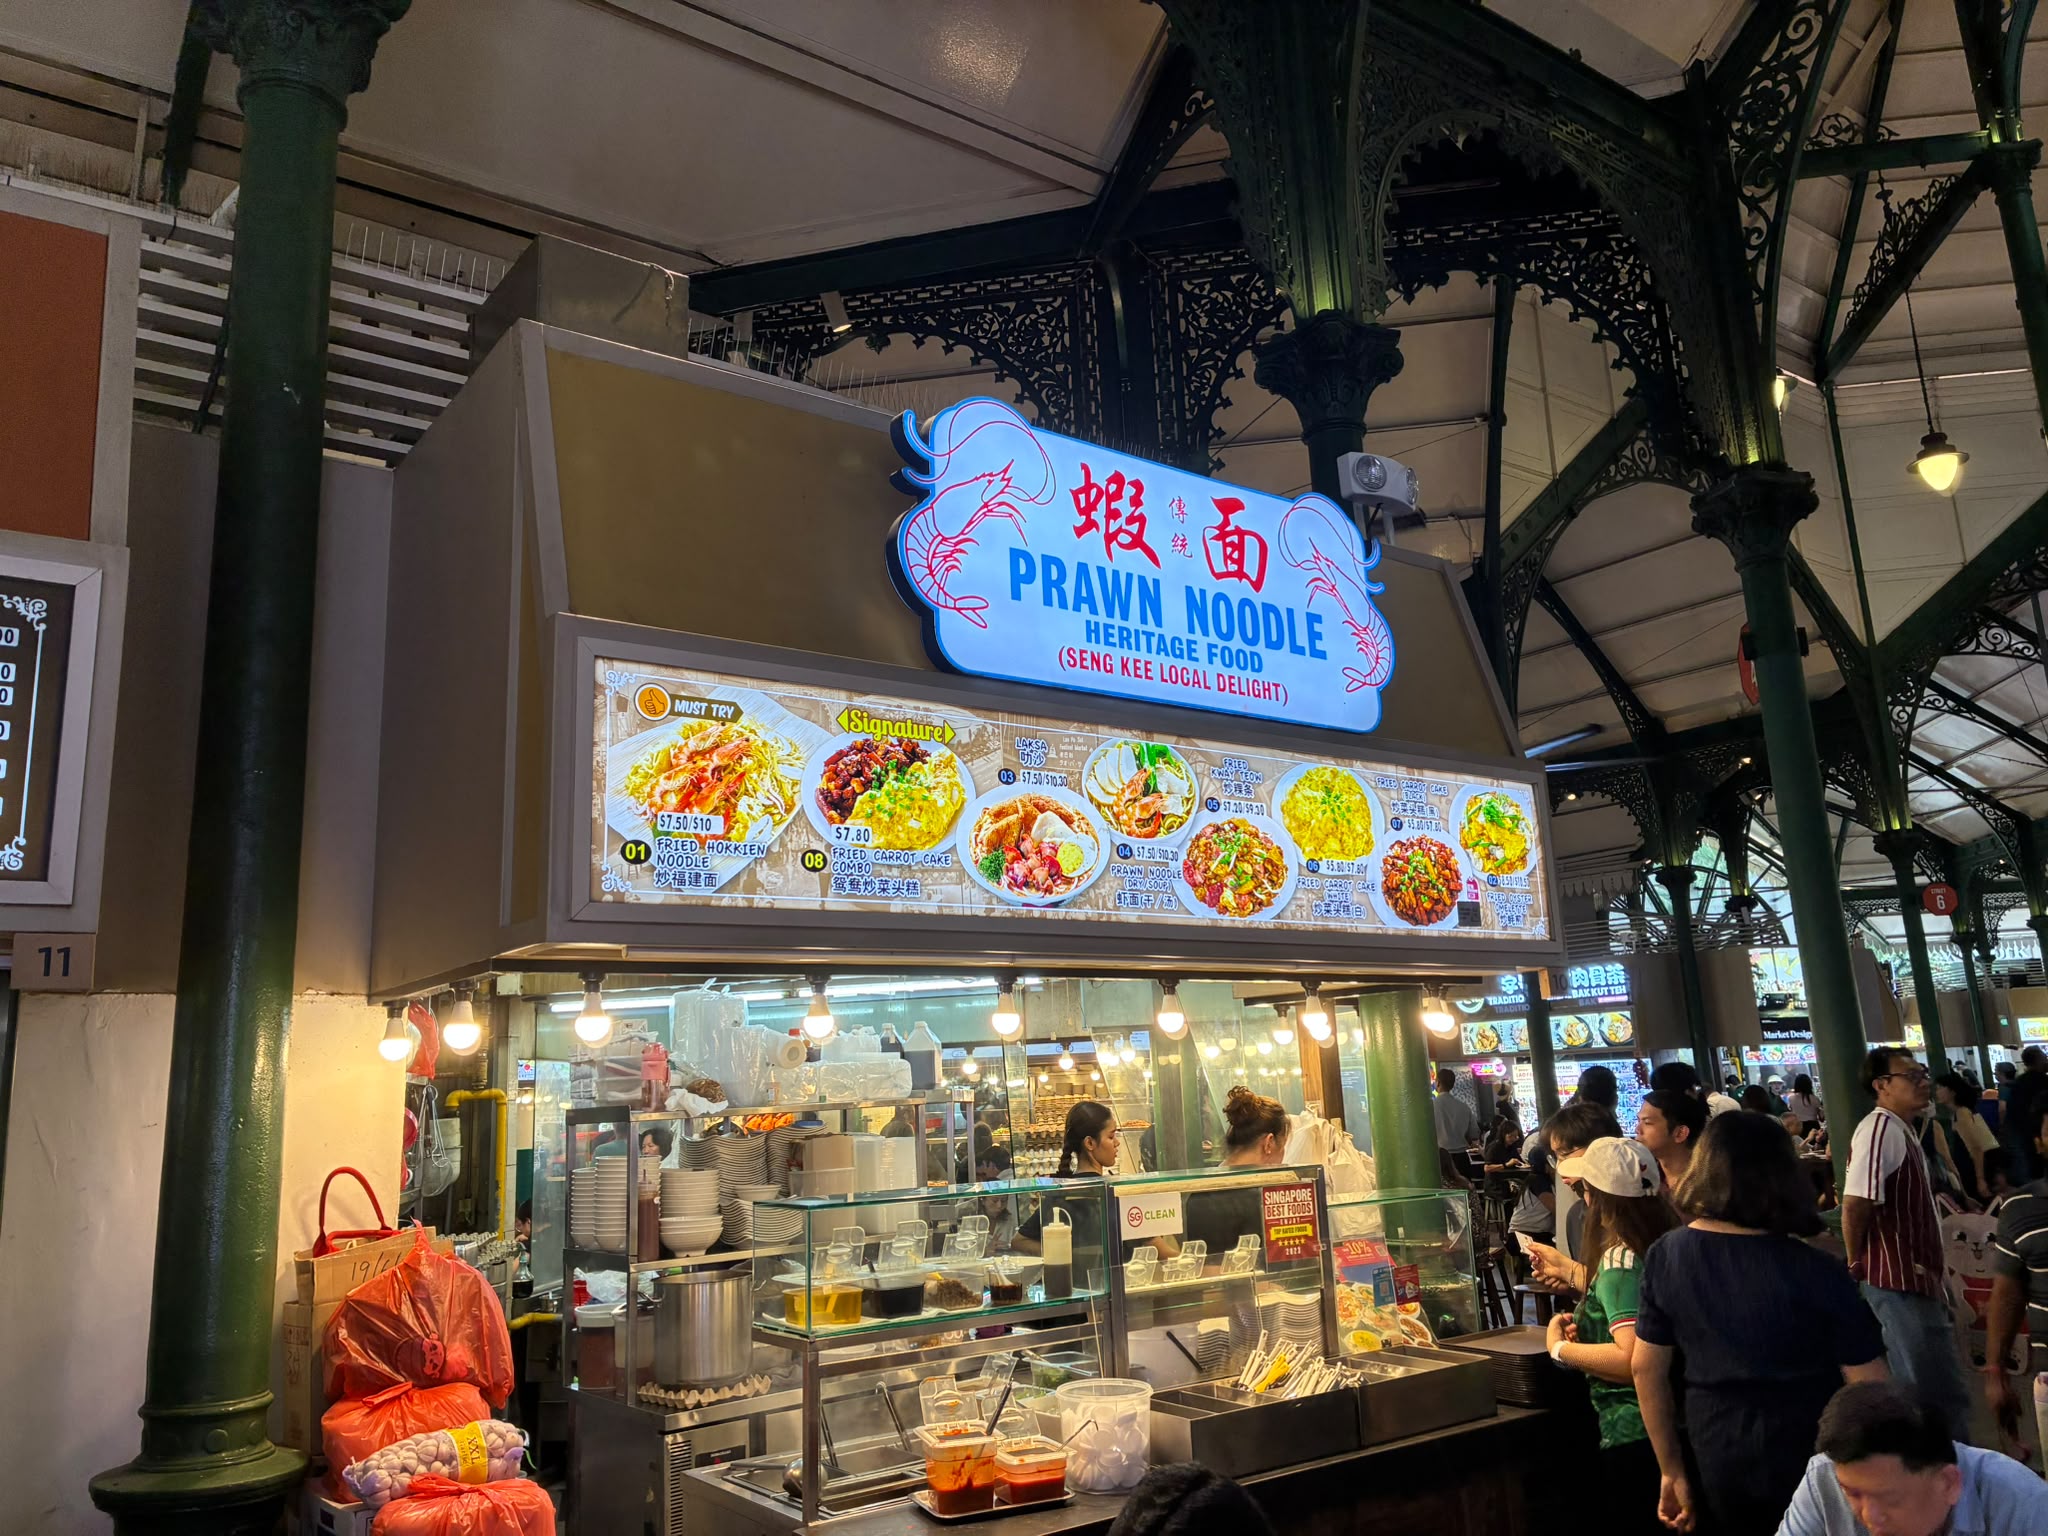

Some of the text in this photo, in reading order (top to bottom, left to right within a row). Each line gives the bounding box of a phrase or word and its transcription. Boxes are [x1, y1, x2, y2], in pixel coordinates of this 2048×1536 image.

[1069, 461, 1268, 592] 蝦 面
[1008, 546, 1328, 661] PRAWN NOODLE
[1085, 619, 1263, 673] HERITAGE FOOD
[1058, 645, 1289, 706] (SENG KEE LOCAL DELIGHT)
[675, 700, 735, 719] MUST TRY
[849, 709, 945, 743] Signature
[1016, 738, 1047, 751] LAKSA
[1020, 751, 1045, 767] 叻沙
[1223, 758, 1248, 770] FRIED
[1000, 771, 1014, 783] 03
[1022, 771, 1068, 787] $7.50/$10.30
[1211, 767, 1262, 783] KWAY TEOW
[1377, 777, 1448, 795] FRIED CARROT CAKE
[1207, 799, 1219, 811] 05
[660, 814, 712, 832] $7.50/$10
[835, 827, 870, 842] $7.80
[625, 843, 646, 860] 01
[656, 837, 765, 856] FRIED HOKKIEN
[1118, 845, 1131, 857] 04
[1137, 846, 1179, 862] $7.50/$10.30
[656, 854, 709, 868] NOODLE
[805, 853, 824, 869] 08
[832, 847, 951, 866] FRIED CARROT CAKE
[832, 862, 871, 874] COMBO
[1111, 865, 1182, 879] PRAWN NOODLE
[1308, 860, 1319, 871] 06
[655, 870, 719, 888] 炒福建面
[1125, 878, 1172, 891] (DRY/SOUP)
[1297, 877, 1376, 892] FRIED CARROT CAKE
[1487, 892, 1532, 903] FRIED OYSTER
[1936, 895, 1946, 910] 6
[37, 946, 72, 978] 11
[1552, 974, 1568, 991] 10
[1571, 963, 1626, 988] 肉骨茶
[1571, 985, 1627, 998] BAK KUT TEH
[1487, 994, 1526, 1006] TRADITIO
[1763, 1030, 1813, 1040] Market Desig
[1264, 1188, 1312, 1205] SINGAPORE
[1144, 1208, 1176, 1220] CLEAN
[1267, 1203, 1312, 1218] BEST FOODS
[466, 1437, 480, 1464] XXL
